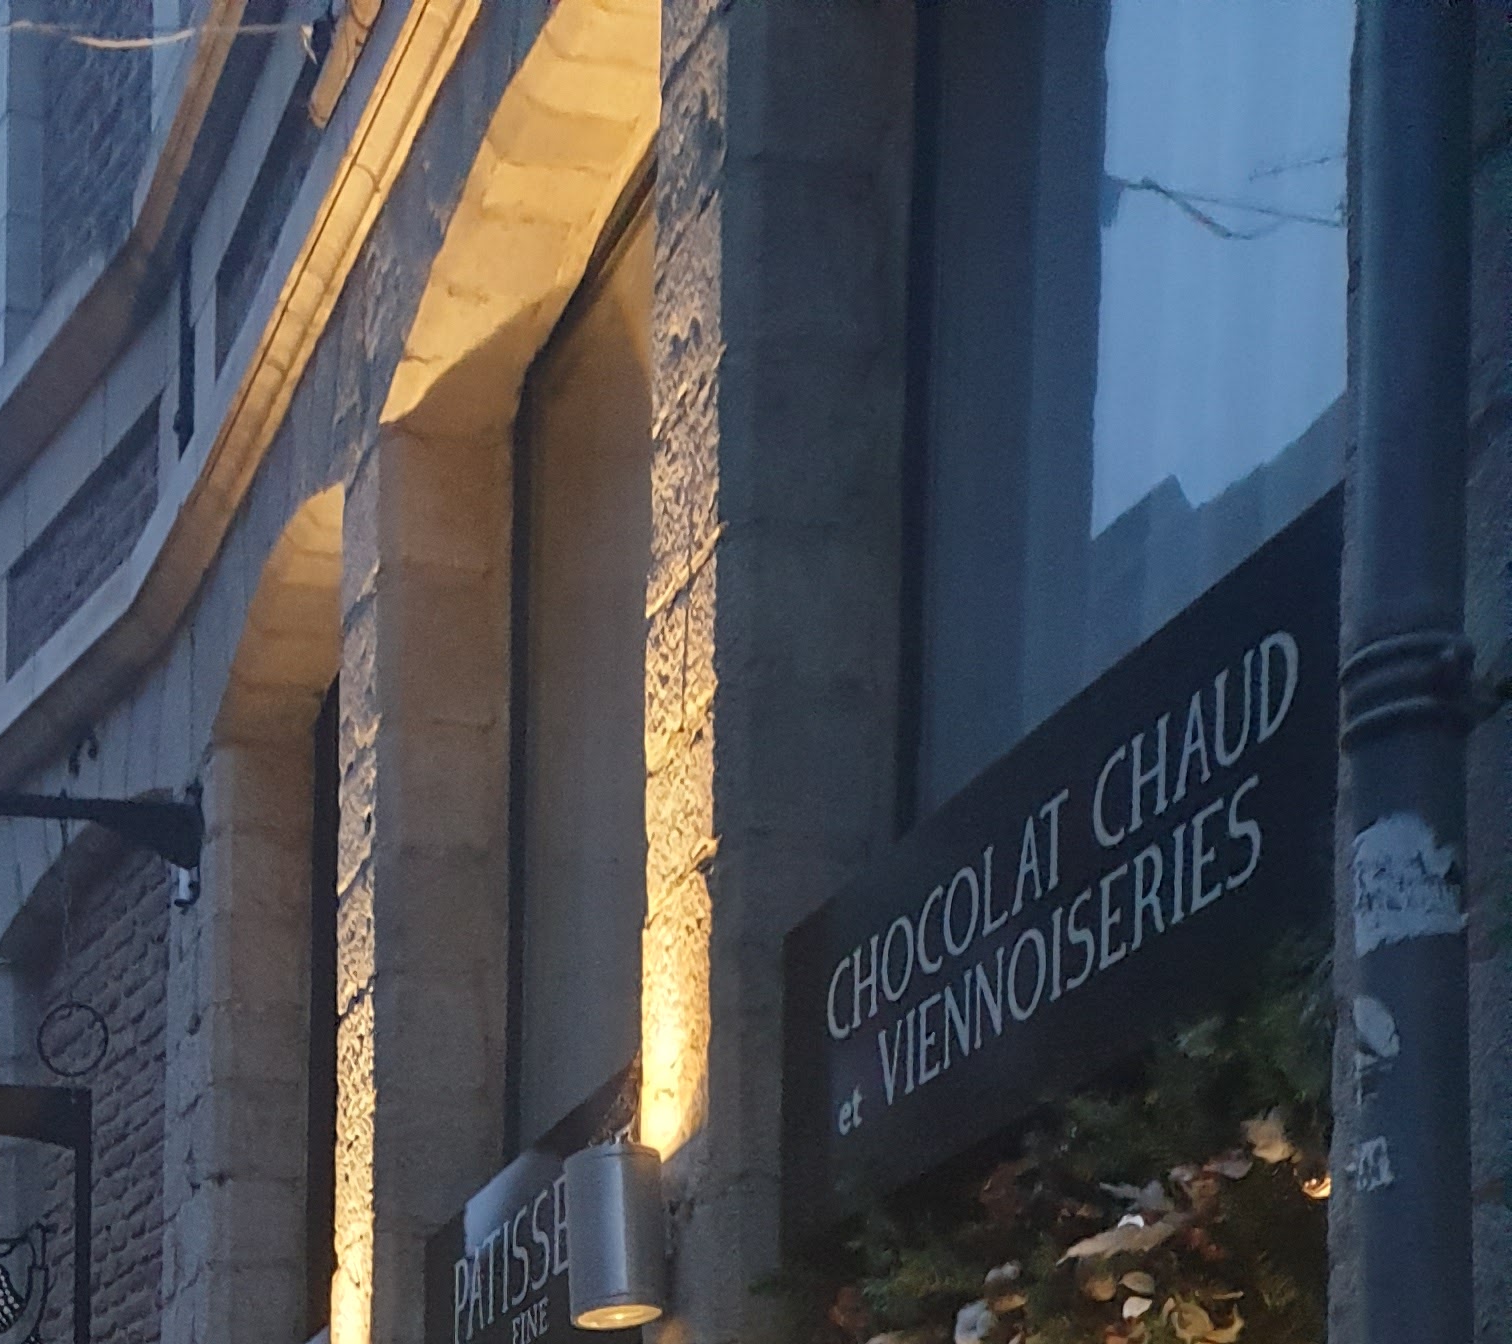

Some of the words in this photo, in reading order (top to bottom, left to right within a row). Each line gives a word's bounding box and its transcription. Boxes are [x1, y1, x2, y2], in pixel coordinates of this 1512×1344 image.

[827, 789, 1068, 1039] CHOCOLAT
[1092, 631, 1298, 848] CHAUD
[838, 1086, 863, 1136] et
[877, 775, 1260, 1106] VIENNOISERIES
